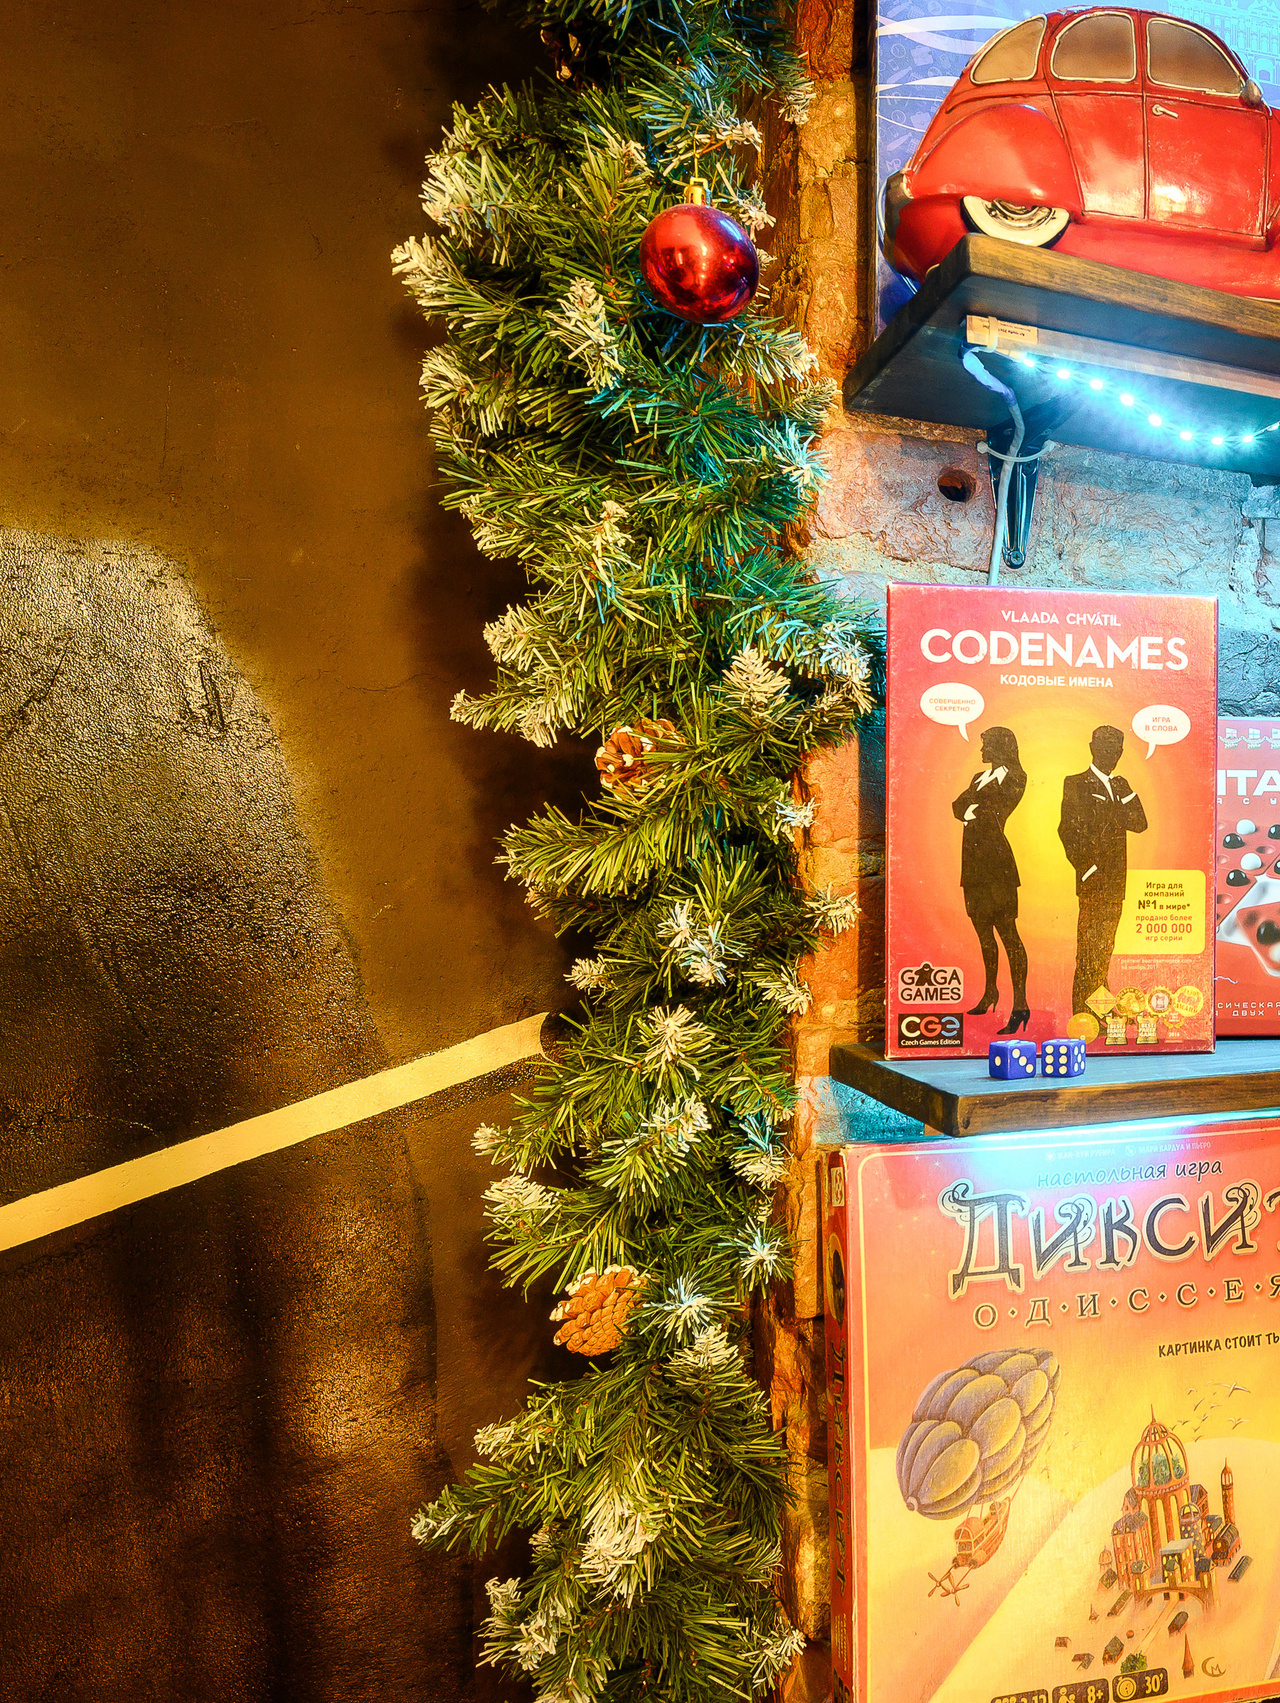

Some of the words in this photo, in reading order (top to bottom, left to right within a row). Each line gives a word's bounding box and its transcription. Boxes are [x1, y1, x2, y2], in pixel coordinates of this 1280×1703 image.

[1001, 610, 1059, 625] VLAADA
[1066, 611, 1121, 628] CHVÁTIL
[920, 628, 1190, 671] CODENAMES
[1000, 674, 1066, 688] КОДОВЫЕ
[1068, 675, 1114, 688] ИМЕНА
[934, 705, 970, 713] СЕКРЕТНО
[1152, 716, 1172, 724] ИГРА
[1146, 881, 1166, 890] Игра
[1138, 899, 1157, 910] №1
[1169, 913, 1193, 921] более
[1136, 923, 1143, 934] 2
[1146, 923, 1168, 934] 000
[1171, 923, 1192, 934] 000
[900, 987, 961, 1001] GAMES
[940, 1038, 961, 1046] Edition
[1036, 1164, 1167, 1188] настольная
[1175, 1160, 1223, 1182] игра
[1158, 1337, 1222, 1358] КАРТИНКА
[1225, 1332, 1262, 1352] СТОИТ
[1087, 1686, 1104, 1702] 8+
